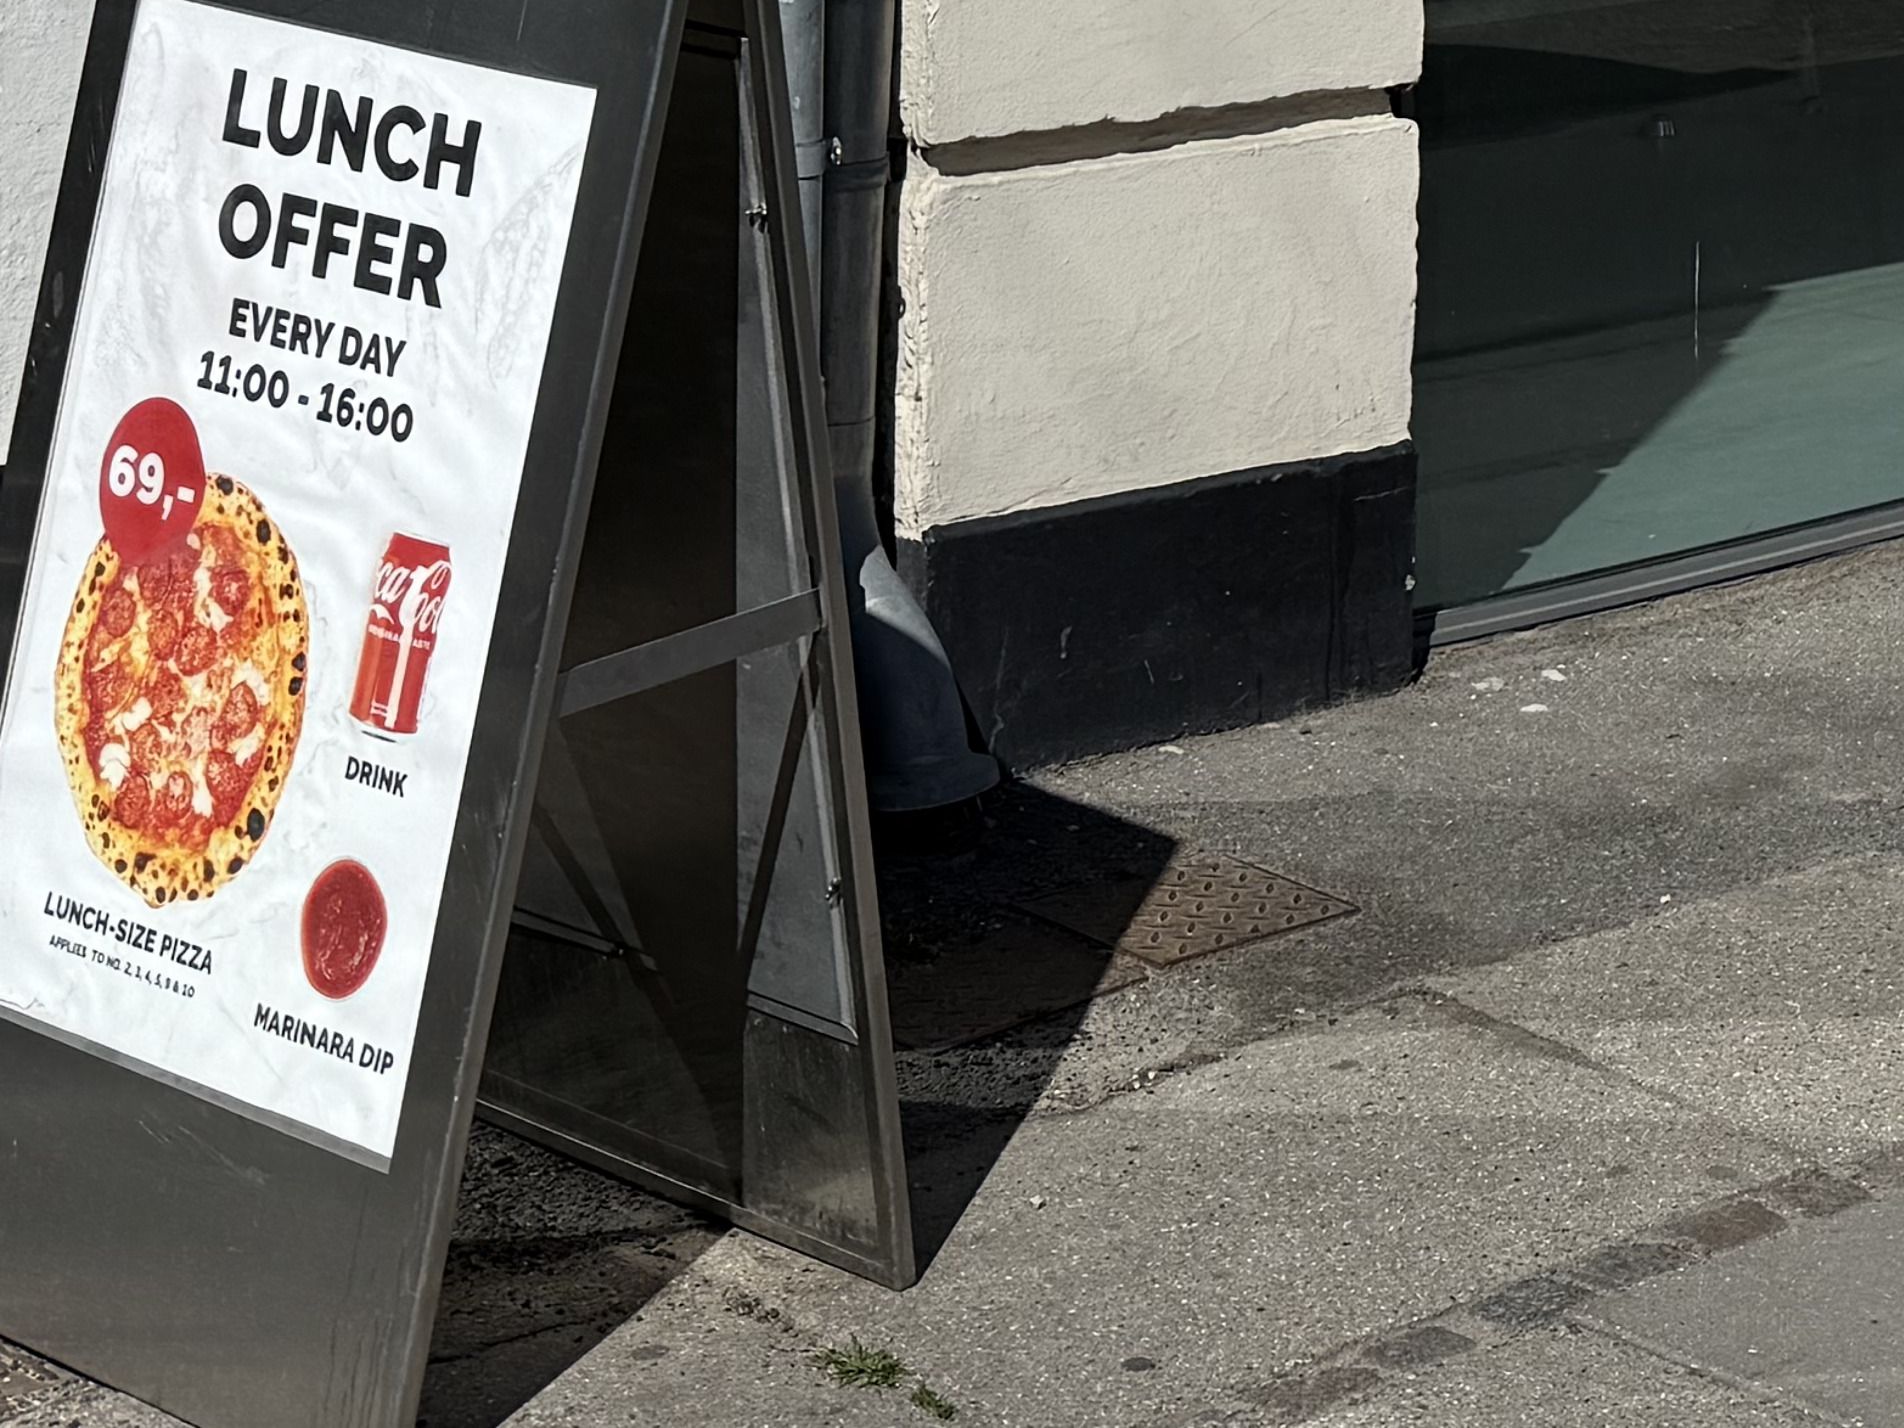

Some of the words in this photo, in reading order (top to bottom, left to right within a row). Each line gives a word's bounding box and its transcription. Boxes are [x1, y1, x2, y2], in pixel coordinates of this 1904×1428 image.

[221, 69, 483, 198] LUNCH
[218, 184, 448, 309] OFFER
[228, 297, 336, 359] EVERY
[338, 325, 407, 378] DAY
[196, 350, 290, 409] 11:00
[316, 382, 414, 444] 16:00
[107, 451, 196, 521] 69,-
[344, 755, 408, 798] DRINK
[43, 891, 157, 954] LUNCH-SIZE
[159, 933, 212, 975] PIZZA
[91, 949, 105, 964] TO
[253, 1001, 354, 1063] MARINARA
[359, 1041, 395, 1075] DIP
